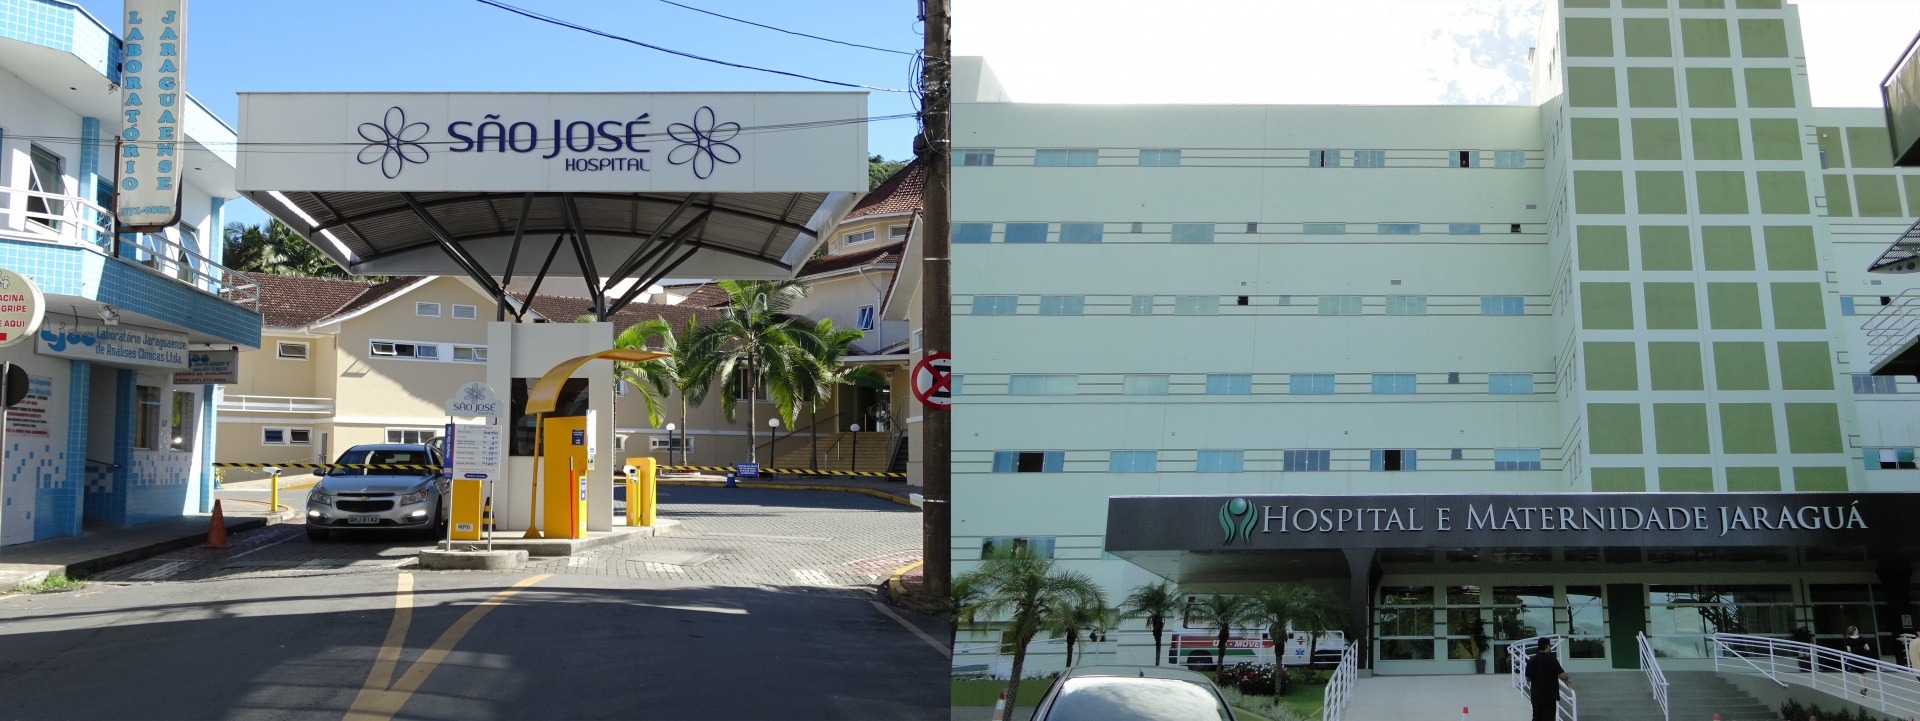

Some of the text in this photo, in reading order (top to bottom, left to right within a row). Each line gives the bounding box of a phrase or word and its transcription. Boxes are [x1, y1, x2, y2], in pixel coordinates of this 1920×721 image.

[121, 11, 144, 191] LABORATÓRIO
[156, 10, 178, 191] JARAGUAENSE
[447, 112, 651, 159] SÃO JOSÉ
[565, 158, 650, 171] HOSPITAL
[95, 342, 105, 354] de
[106, 343, 137, 359] Análises
[138, 347, 165, 362] Clínicas
[96, 326, 187, 350] Laboratório Jaraguaense
[453, 401, 496, 413] SÃO JOSÉ
[1261, 499, 1869, 537] HOSPITAL E MATERNIDADE JARAGUÁ
